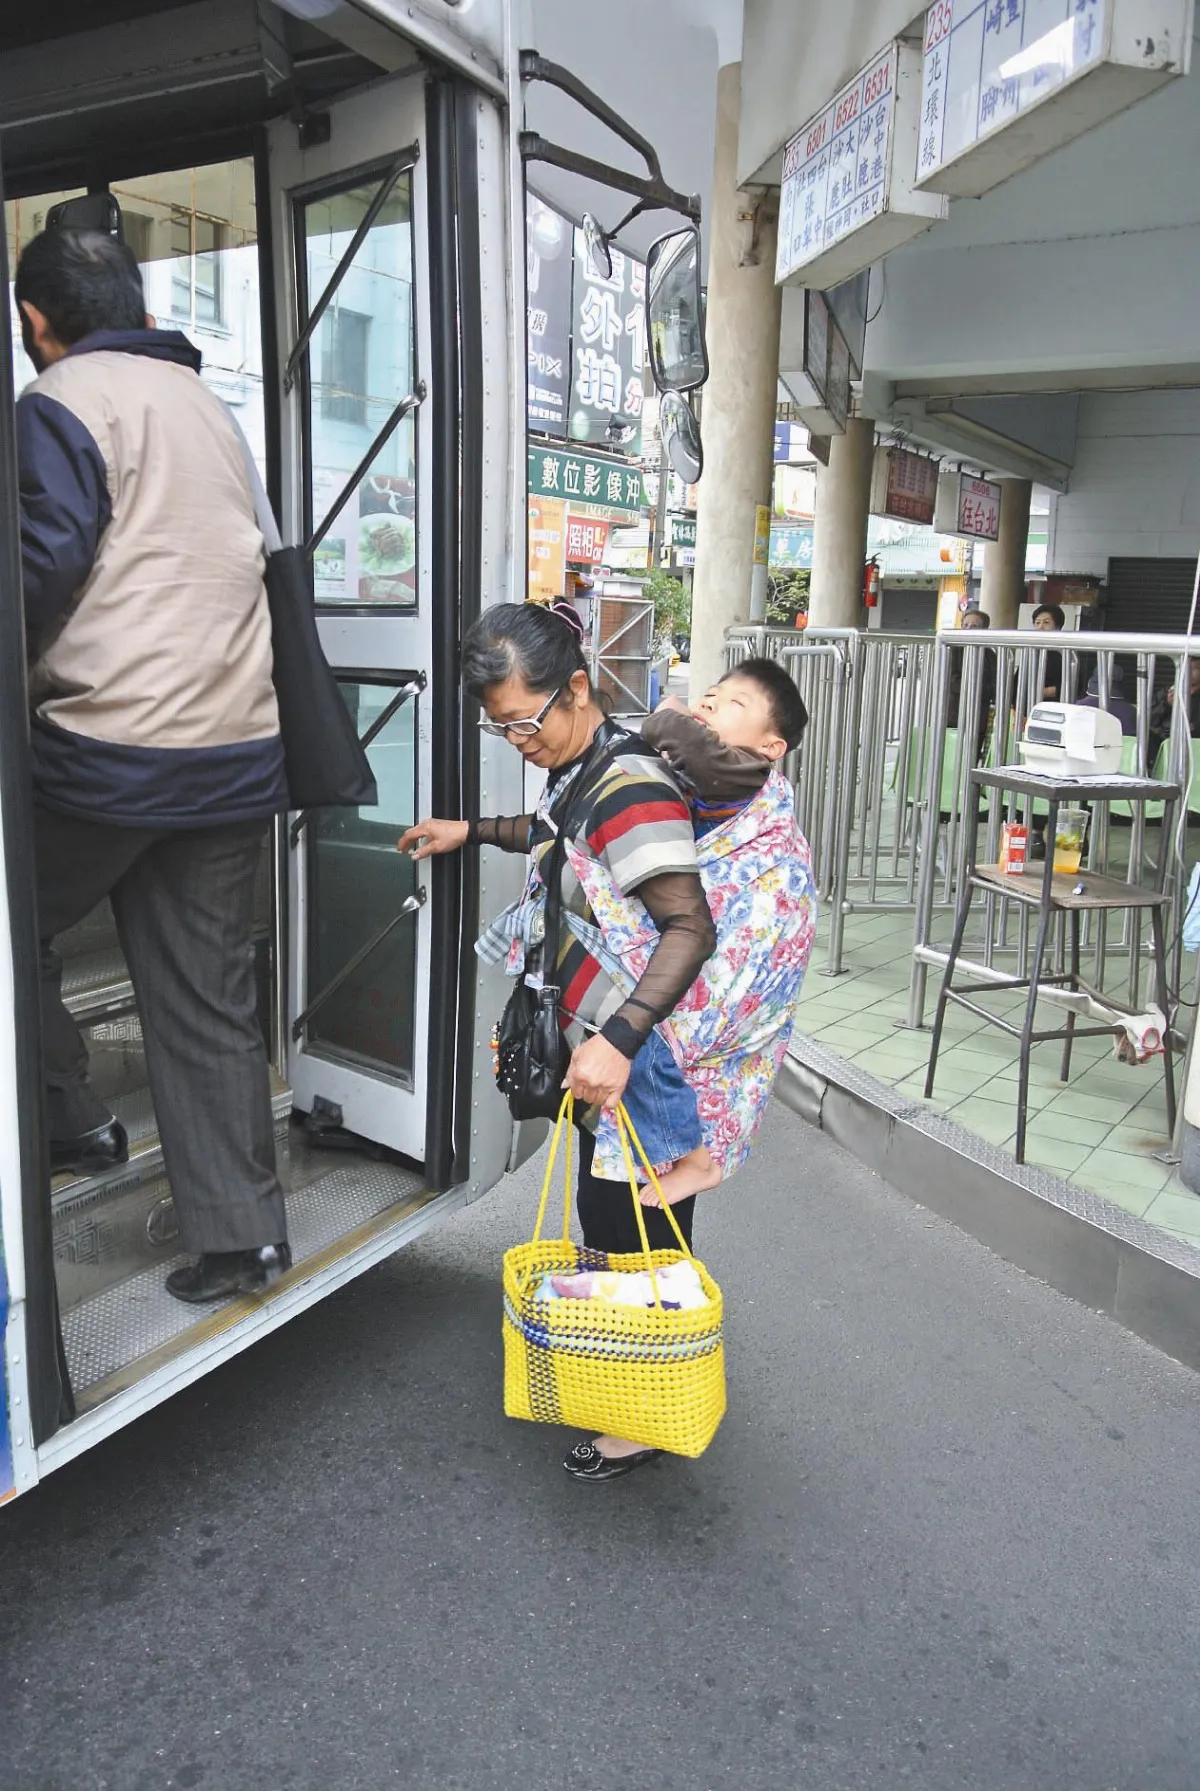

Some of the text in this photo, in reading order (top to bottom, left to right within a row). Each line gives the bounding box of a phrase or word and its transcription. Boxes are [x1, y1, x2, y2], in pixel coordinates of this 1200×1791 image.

[865, 62, 889, 105] 6531
[836, 89, 859, 130] 6522
[922, 52, 942, 166] 北環線
[806, 118, 826, 158] 6501
[528, 455, 641, 505] 數位影像沖
[962, 498, 997, 535] 往台北
